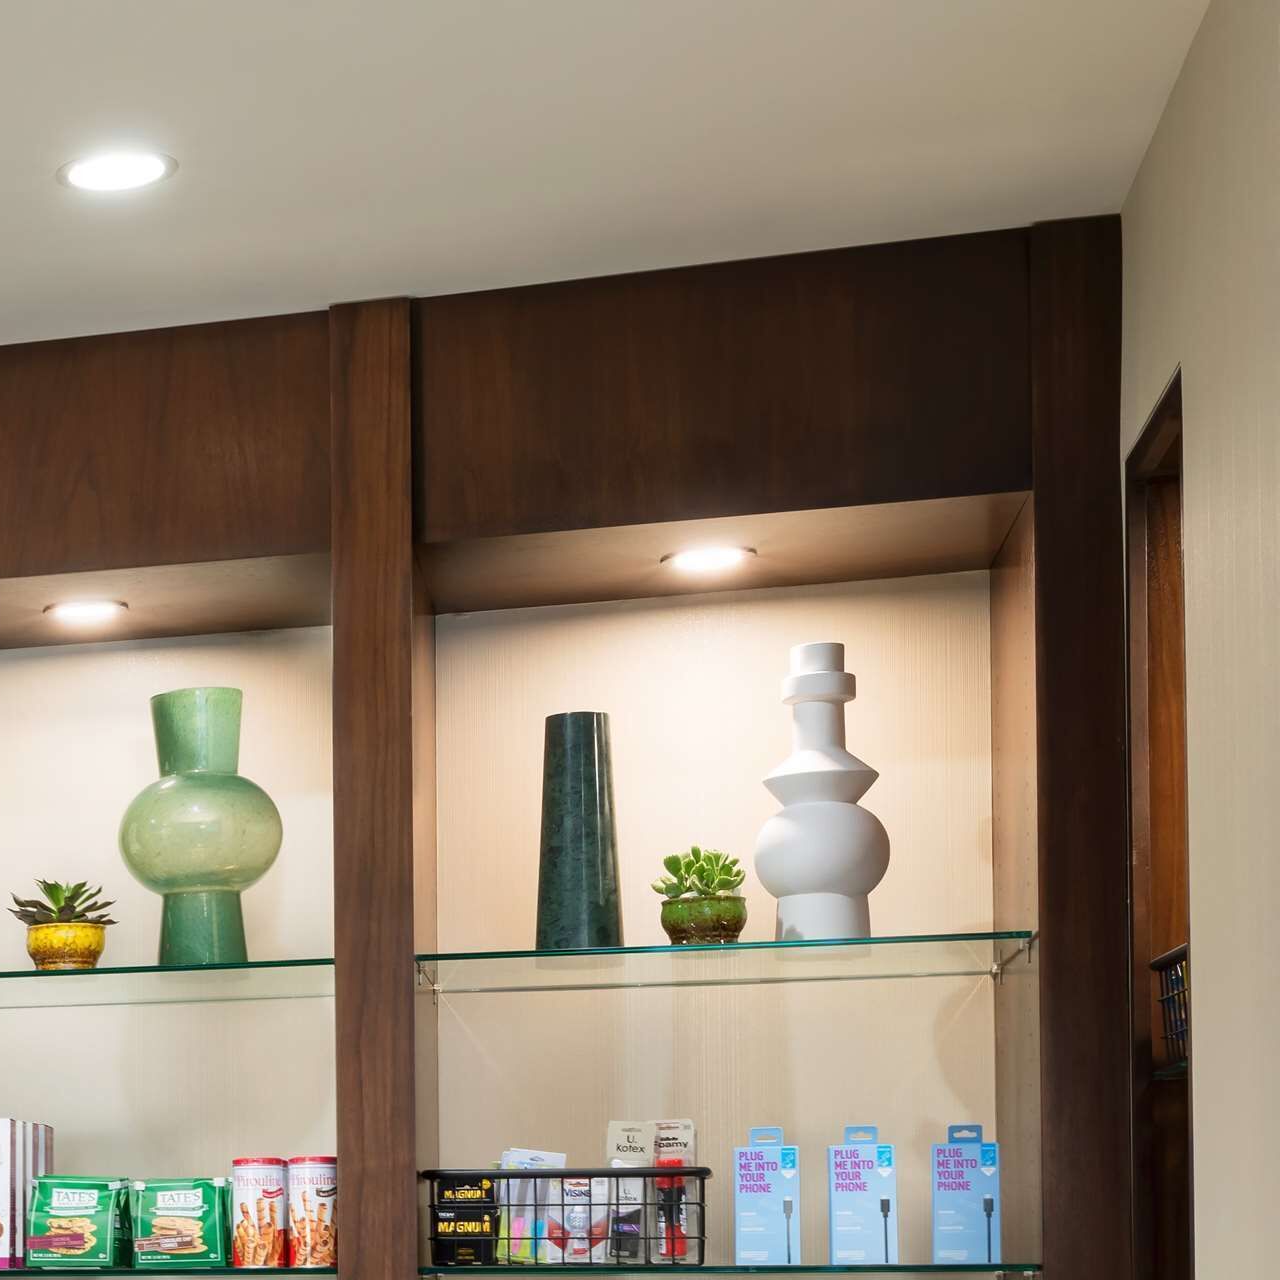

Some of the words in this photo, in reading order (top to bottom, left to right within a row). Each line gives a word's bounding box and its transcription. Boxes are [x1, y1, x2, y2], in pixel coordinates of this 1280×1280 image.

[739, 1151, 764, 1161] PLUG
[834, 1149, 859, 1159] PLUG
[936, 1148, 962, 1158] PLUG
[739, 1162, 753, 1171] ME
[755, 1162, 778, 1171] INTO
[834, 1160, 848, 1170] ME
[850, 1160, 874, 1170] INTO
[936, 1159, 951, 1169] ME
[953, 1159, 977, 1169] INTO
[738, 1172, 766, 1183] YOUR
[834, 1171, 861, 1181] YOUR
[937, 1170, 964, 1180] YOUR
[739, 1183, 772, 1193] PHONE
[834, 1182, 868, 1192] PHONE
[937, 1181, 971, 1191] PHONE
[55, 1191, 97, 1202] TATE'S
[159, 1190, 201, 1204] TATE'S
[437, 1221, 491, 1233] MAGNUM
